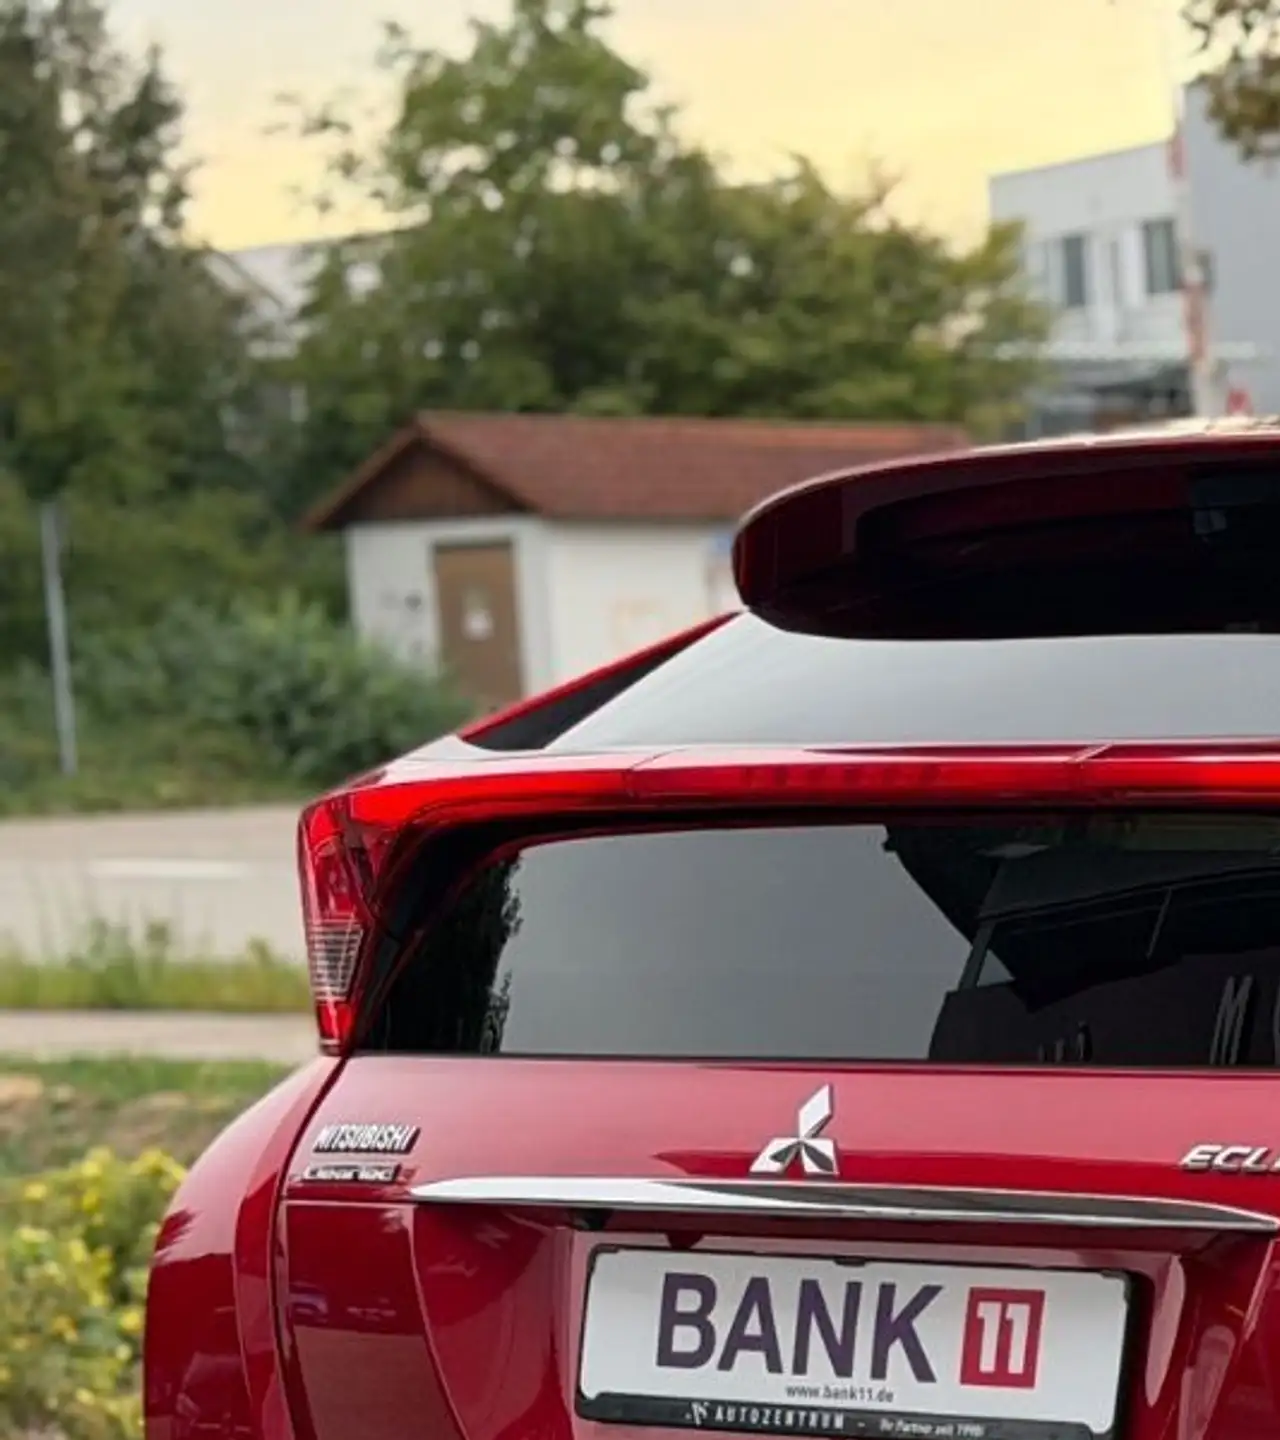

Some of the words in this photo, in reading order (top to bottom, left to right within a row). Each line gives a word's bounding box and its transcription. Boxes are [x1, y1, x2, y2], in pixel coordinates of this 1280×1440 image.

[654, 1272, 944, 1385] BANK
[972, 1297, 1034, 1377] 11
[784, 1384, 895, 1403] www.bank11.de
[714, 1405, 845, 1429] AUTOZENTRUM
